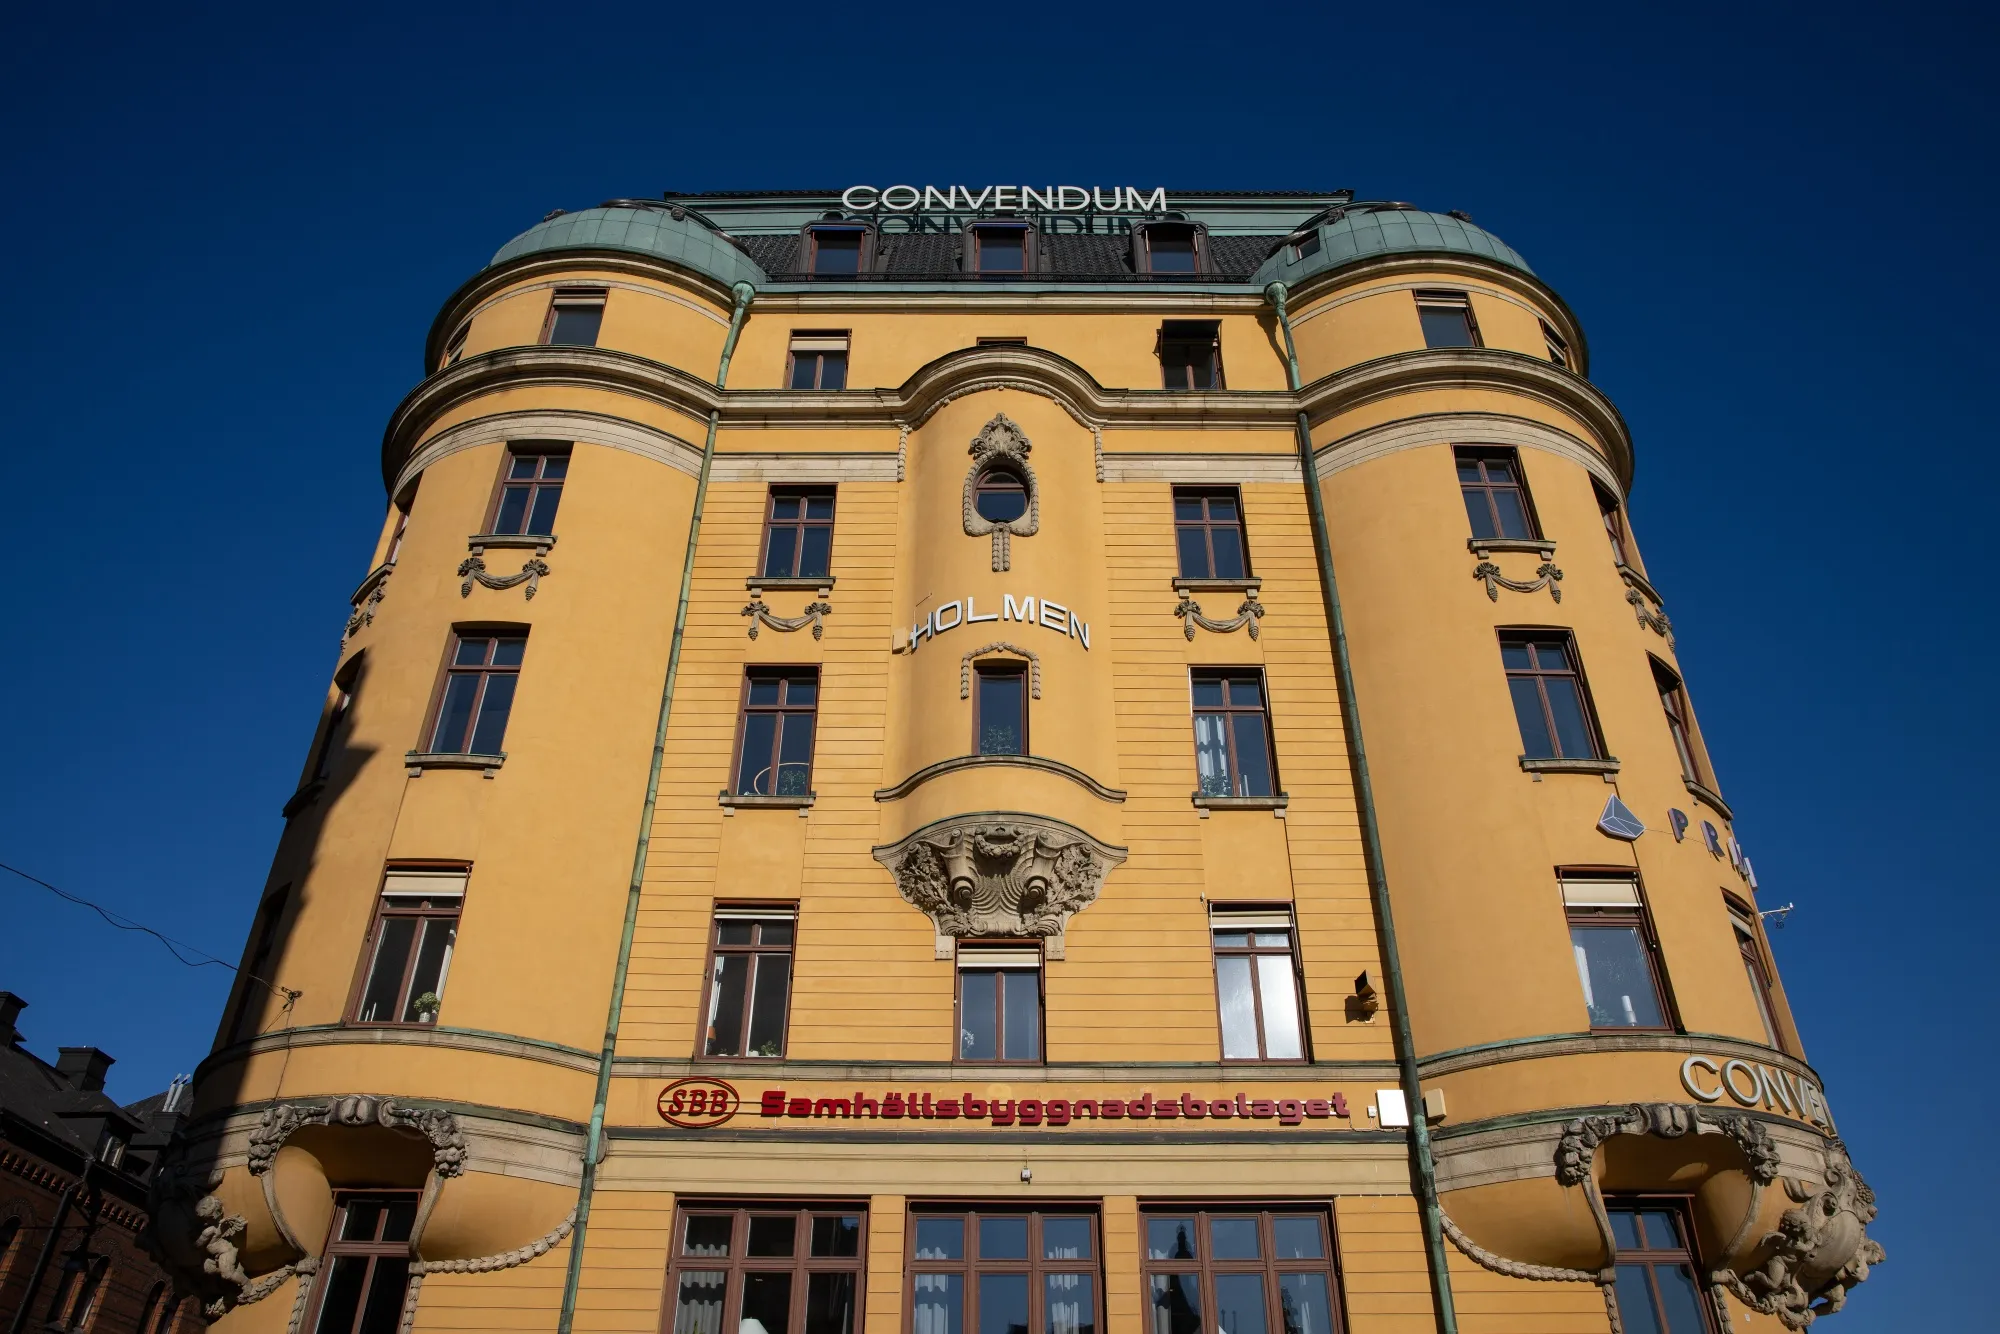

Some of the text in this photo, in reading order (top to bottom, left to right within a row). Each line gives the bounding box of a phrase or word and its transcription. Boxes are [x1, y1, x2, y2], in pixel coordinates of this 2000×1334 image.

[842, 185, 1167, 212] CONVENDUM
[911, 593, 1089, 651] HOLMEN
[667, 1088, 1350, 1126] SBB Samhällsbyggnadsbolaget
[1680, 1055, 1838, 1137] CONVE
